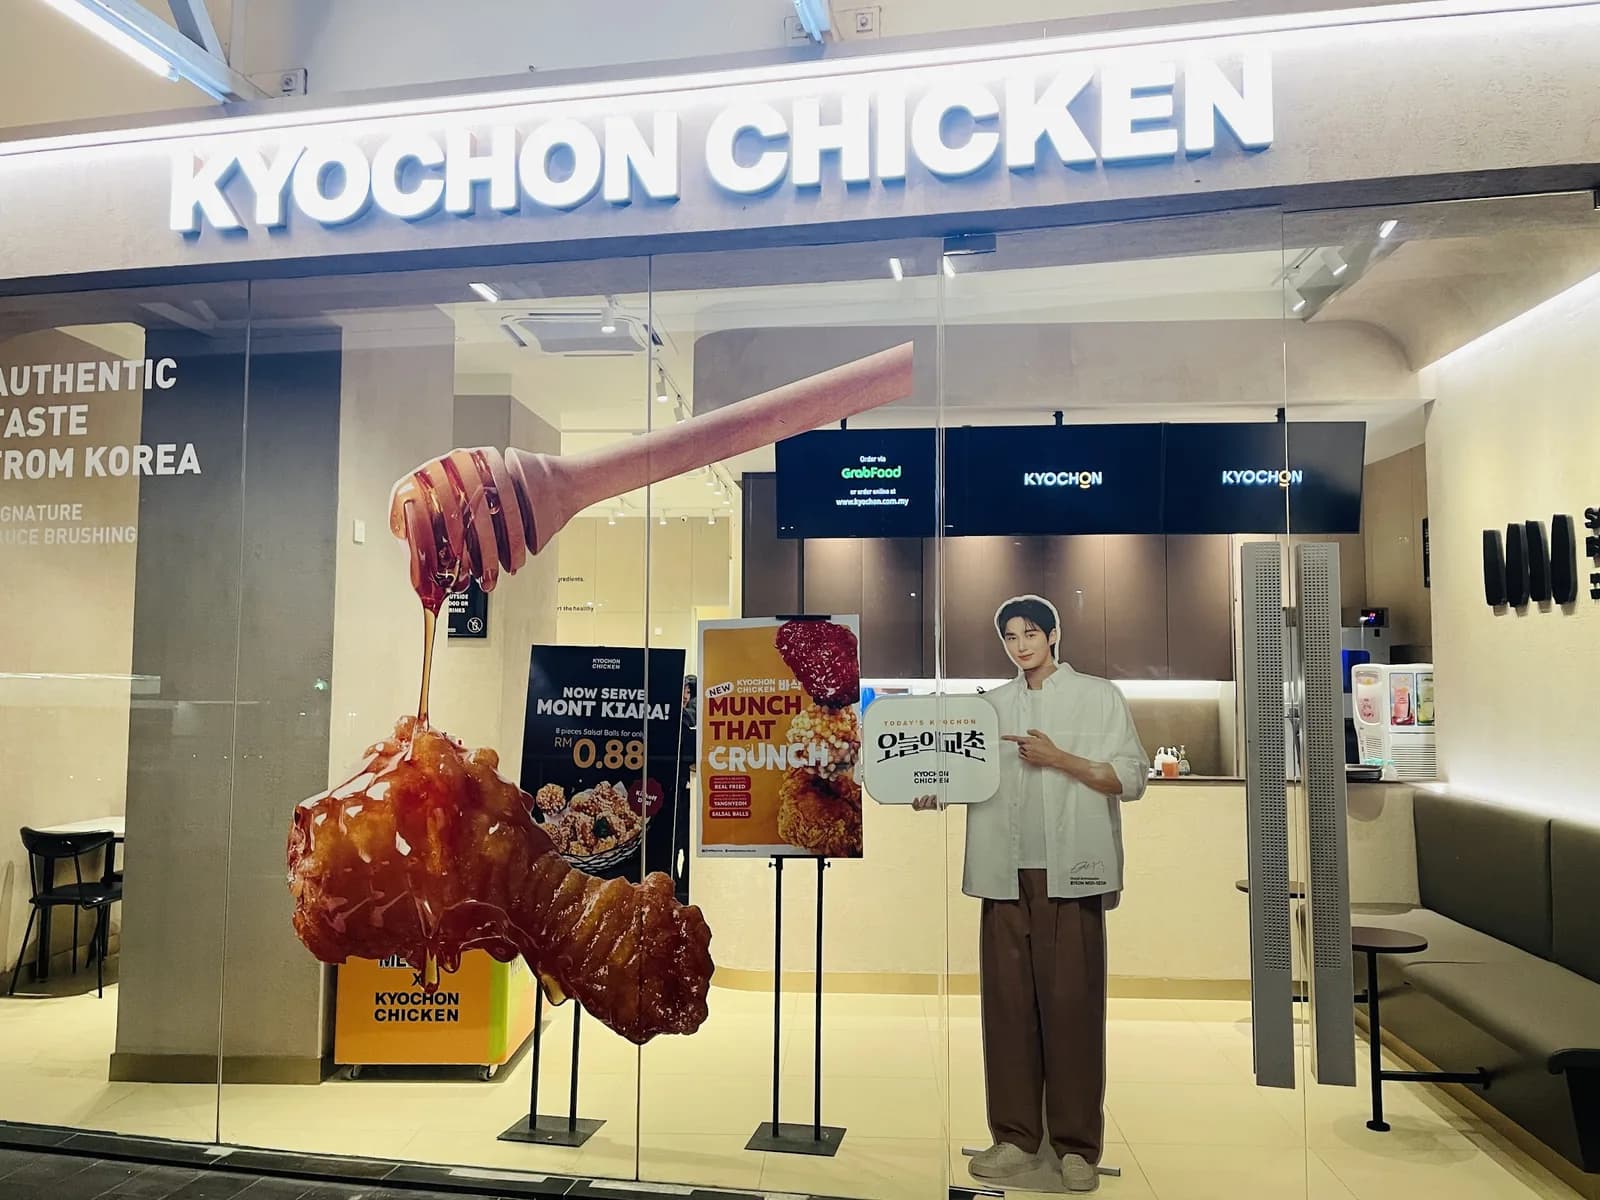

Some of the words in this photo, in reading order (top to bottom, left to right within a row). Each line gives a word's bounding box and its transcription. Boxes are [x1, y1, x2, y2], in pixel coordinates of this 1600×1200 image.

[170, 109, 680, 234] KYOCHON
[705, 46, 1275, 194] CHICKEN
[0, 448, 73, 480] ROM
[84, 443, 201, 478] KOREA
[841, 465, 901, 479] GrabFood
[1024, 471, 1103, 489] KYOCHON
[1222, 469, 1303, 487] KYOCHON
[44, 526, 138, 545] BRUSHING
[709, 683, 732, 698] NEW
[737, 678, 776, 687] KYOCHON
[563, 687, 598, 699] NOW
[536, 699, 597, 717] MONT
[601, 702, 671, 720] KIARA!
[708, 695, 802, 716] MUNCH
[561, 728, 582, 736] pieces
[604, 729, 620, 737] Balls
[709, 720, 776, 740] THAT
[554, 737, 573, 748] RM
[573, 738, 645, 770] 0.88
[708, 742, 829, 772] CRUNCH
[375, 992, 459, 1005] KYOCHON
[374, 1008, 459, 1022] CHICKEN
